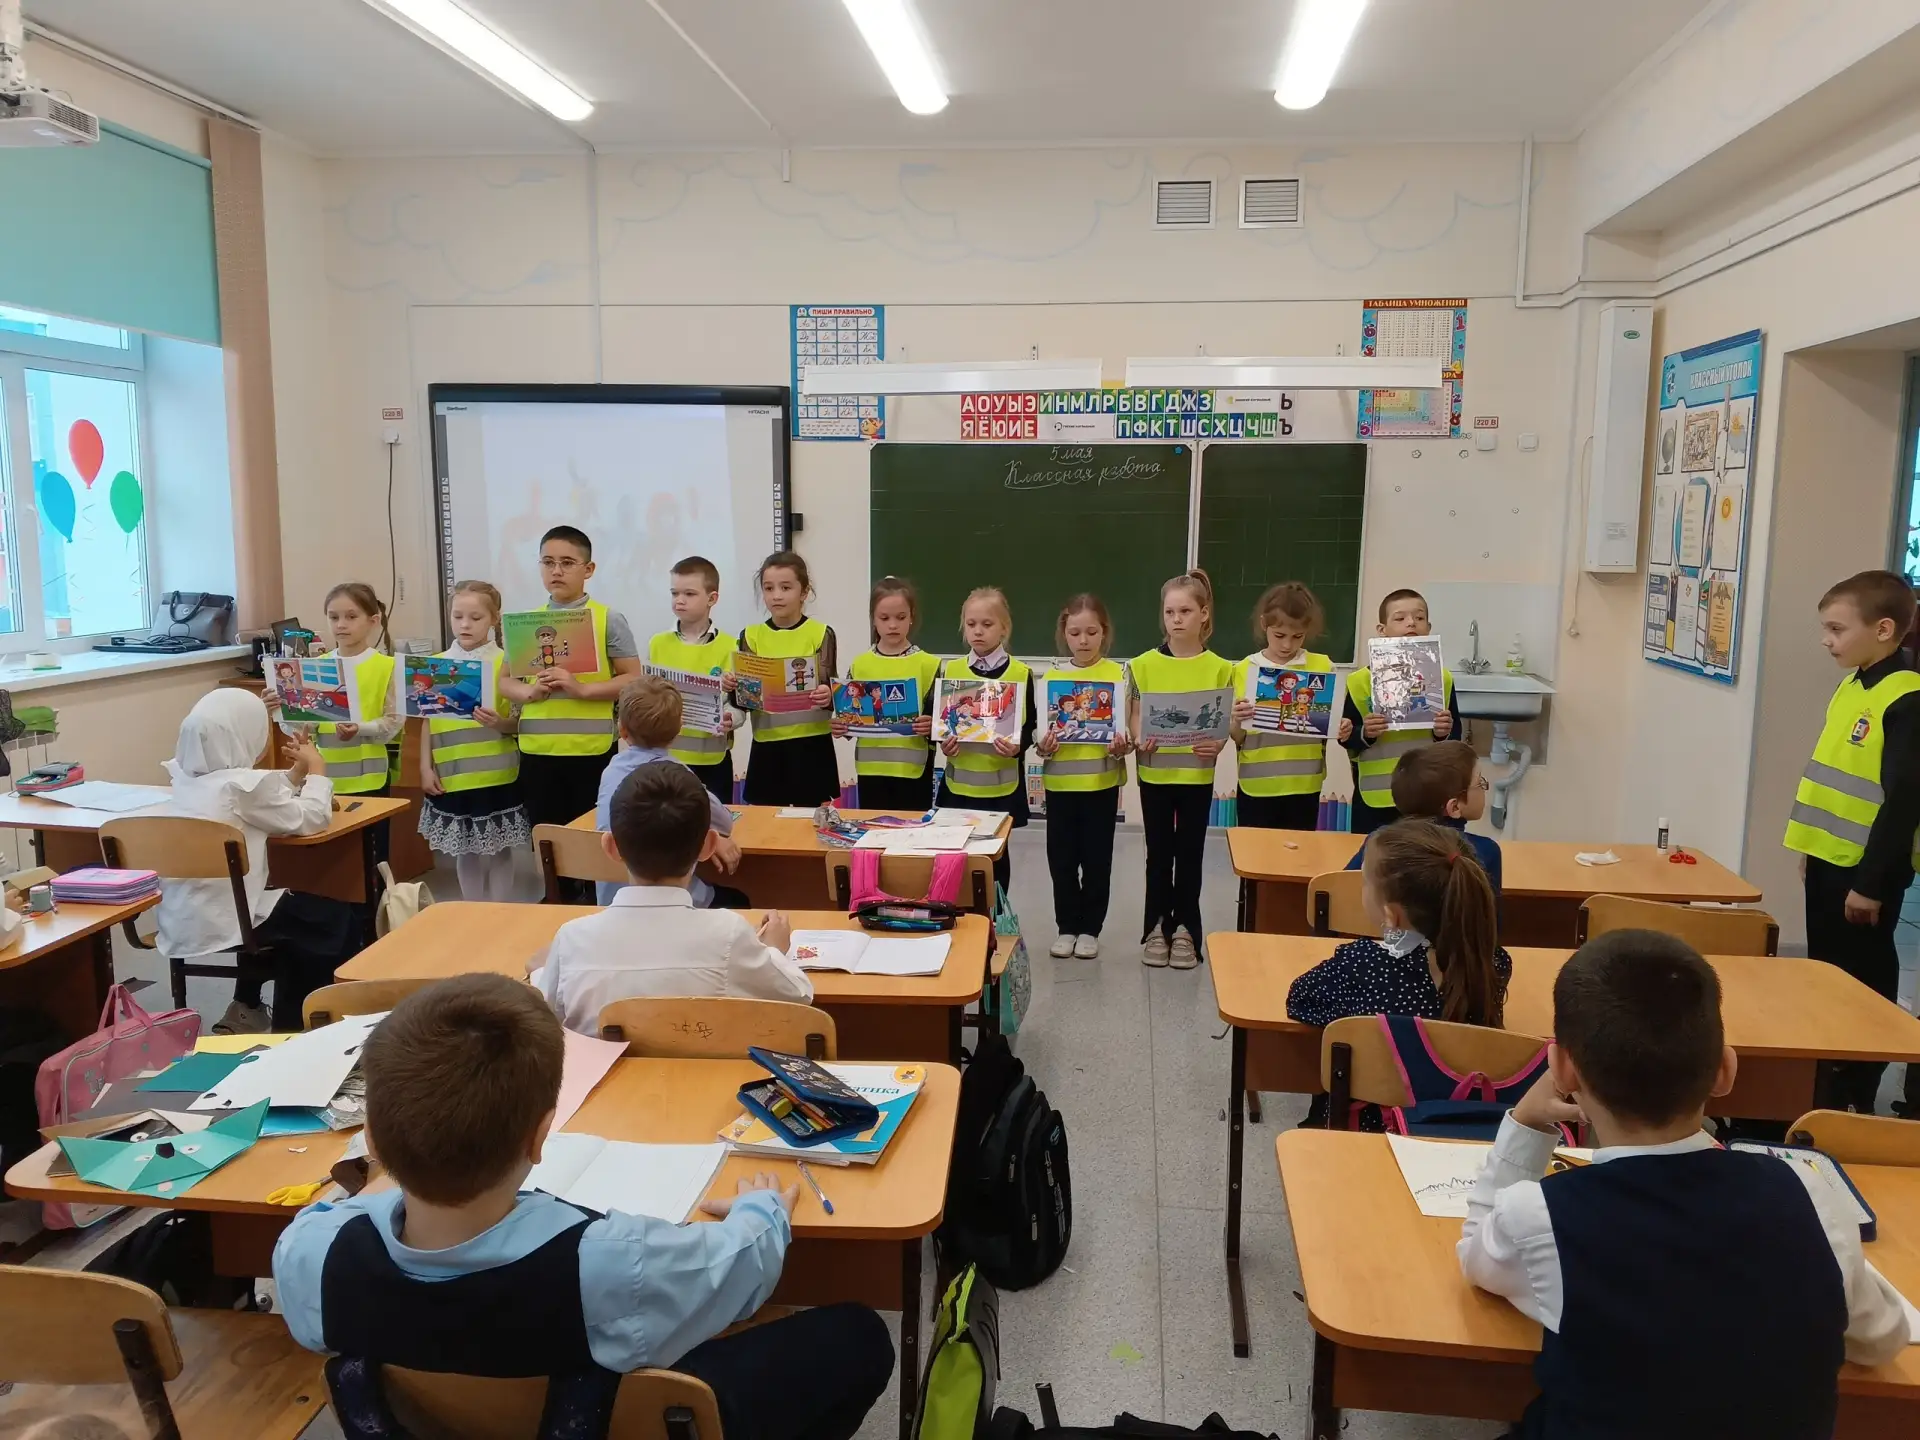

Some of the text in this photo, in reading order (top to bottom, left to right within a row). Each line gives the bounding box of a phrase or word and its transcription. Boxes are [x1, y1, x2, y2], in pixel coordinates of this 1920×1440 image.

[1409, 299, 1465, 307] УМНОЖЕНИЯ
[1689, 359, 1753, 390] КЛАССНЫЙ УГОЛОК
[1050, 446, 1095, 461] 5 мая
[1004, 459, 1097, 486] Классная
[854, 1084, 900, 1095] атика
